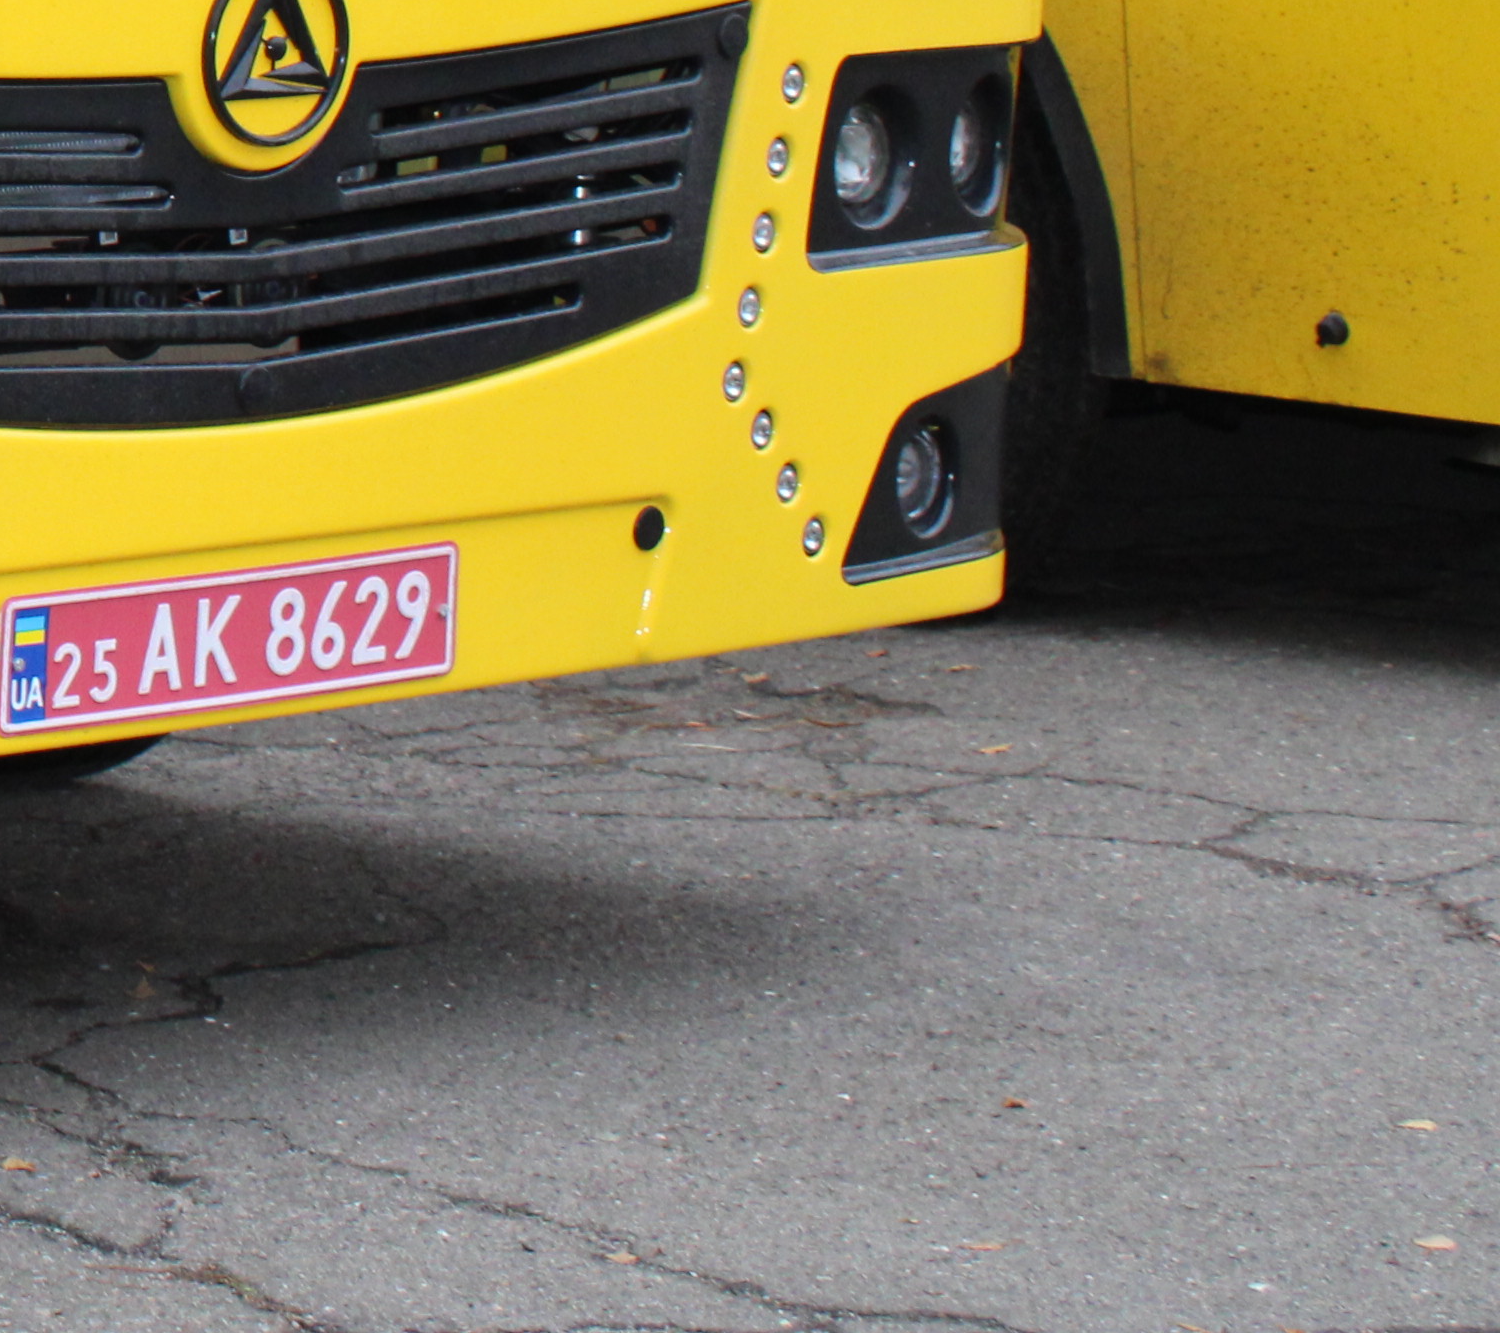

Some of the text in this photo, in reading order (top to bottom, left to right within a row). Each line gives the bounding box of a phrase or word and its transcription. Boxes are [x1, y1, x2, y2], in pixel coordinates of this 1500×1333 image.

[51, 569, 431, 710] 25 AK 8629
[11, 676, 44, 712] UA
